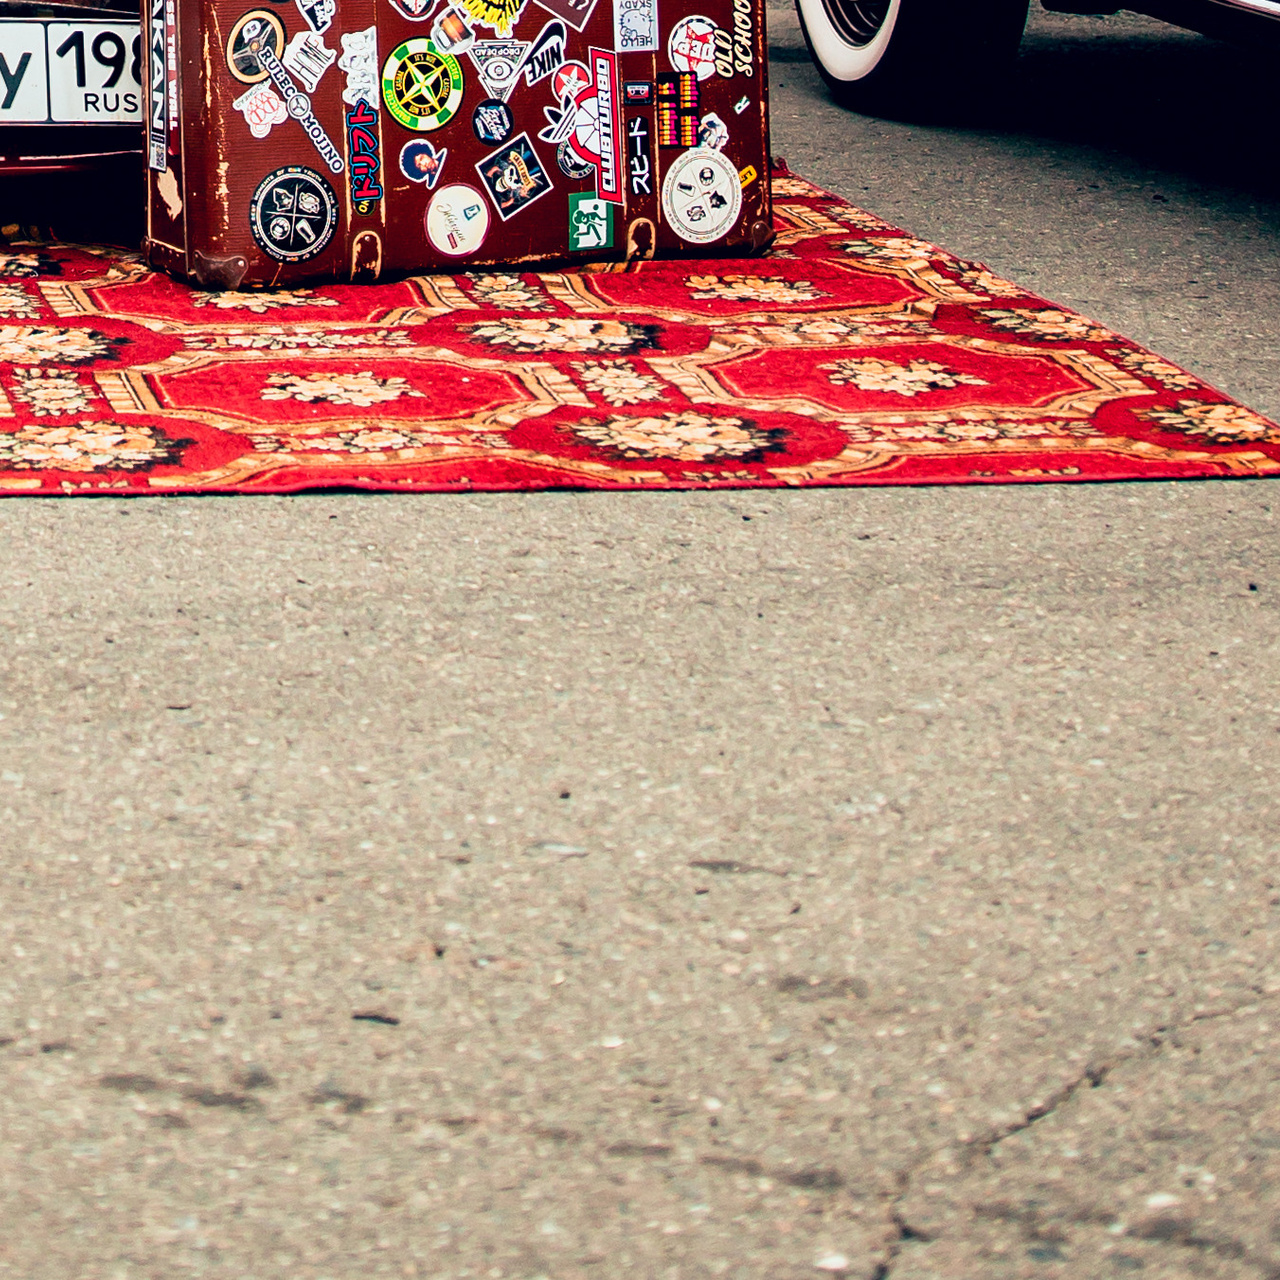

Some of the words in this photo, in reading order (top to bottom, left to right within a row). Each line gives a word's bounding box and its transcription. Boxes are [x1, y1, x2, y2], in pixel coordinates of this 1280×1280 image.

[619, 0, 652, 9] SKADY
[56, 31, 142, 89] 19
[167, 34, 177, 71] THE
[526, 41, 563, 82] NIKE
[621, 37, 652, 47] HELLO
[714, 29, 734, 78] OLD
[84, 93, 138, 113] RUS
[168, 80, 178, 131] WALL
[348, 99, 382, 201] ドリフト
[631, 117, 652, 194] スピード
